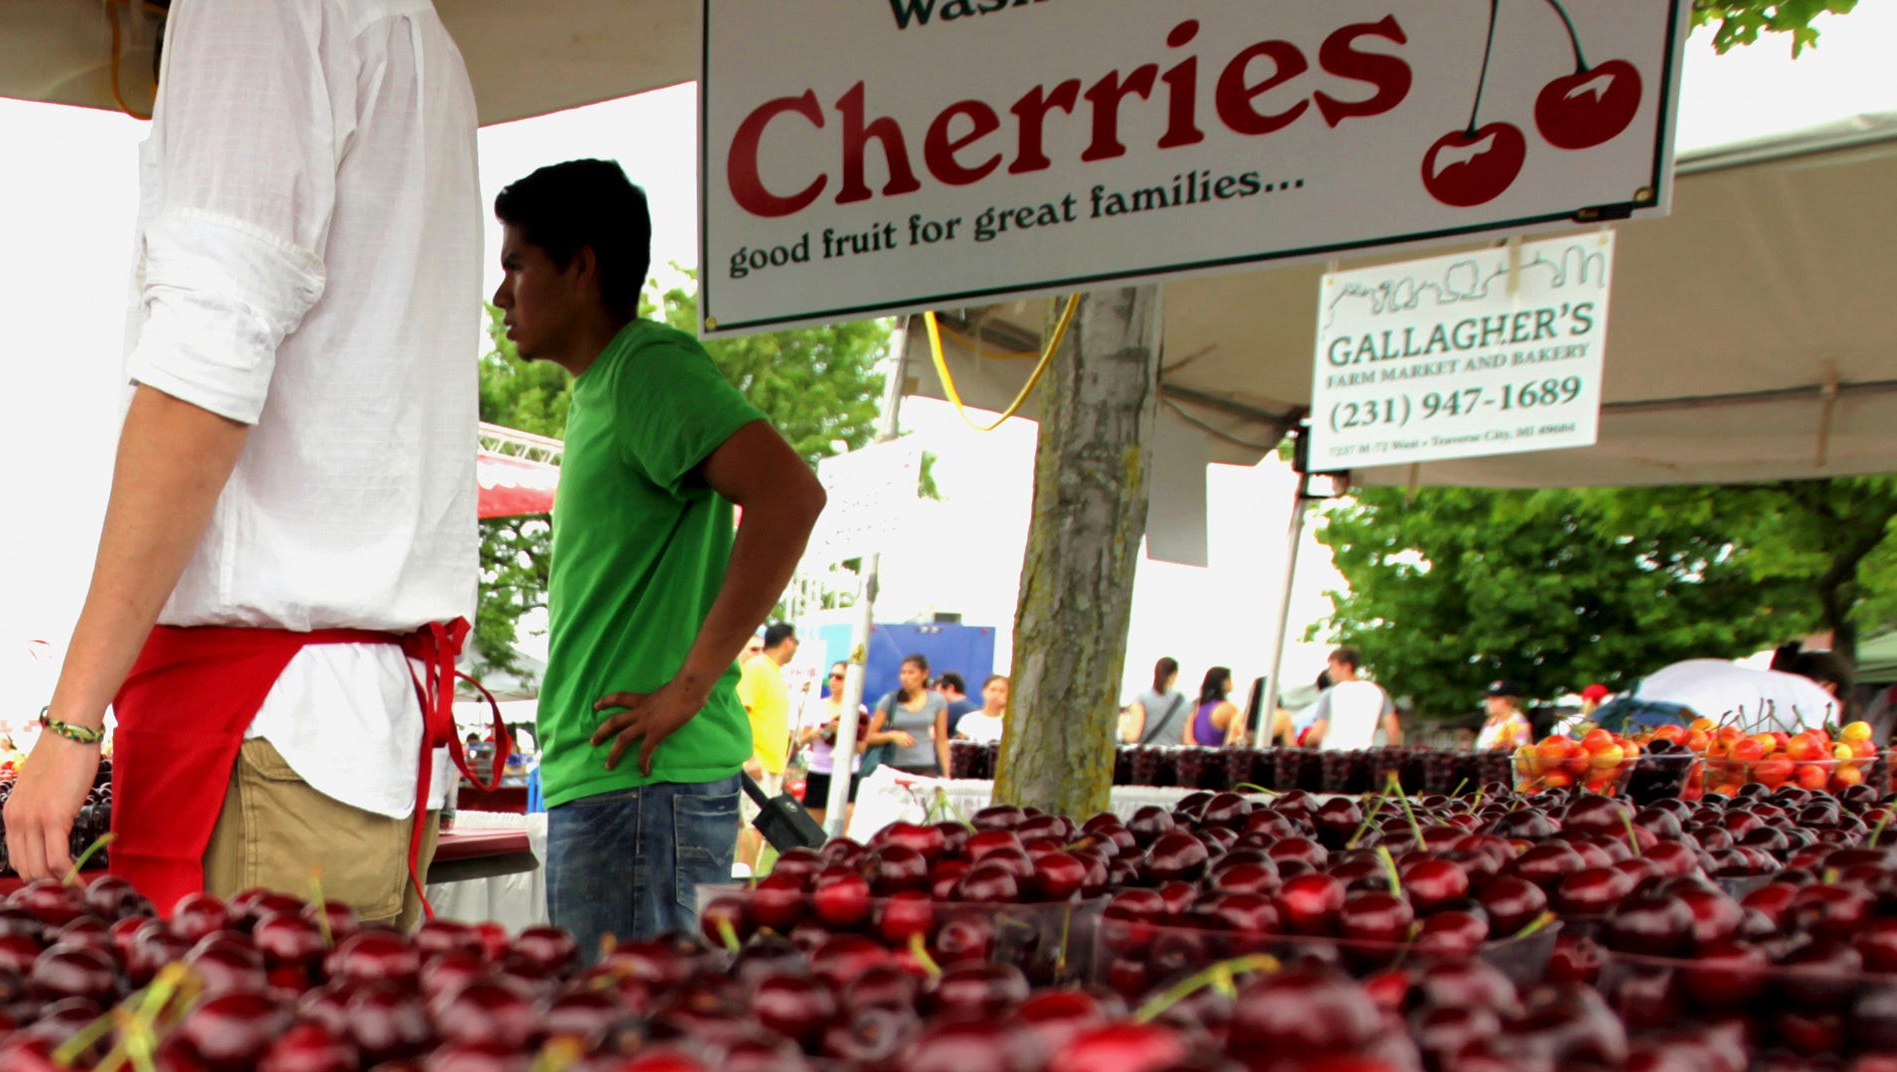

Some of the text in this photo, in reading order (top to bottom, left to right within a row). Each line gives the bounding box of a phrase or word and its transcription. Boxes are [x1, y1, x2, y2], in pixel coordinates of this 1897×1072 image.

[726, 13, 1413, 218] Cherries
[729, 169, 1304, 279] good fruit for great families...
[1327, 301, 1595, 367] GALLAGHER'S
[1327, 343, 1591, 389] FARM MARKET AND BAKERY
[1330, 375, 1582, 433] (231) 947-1689
